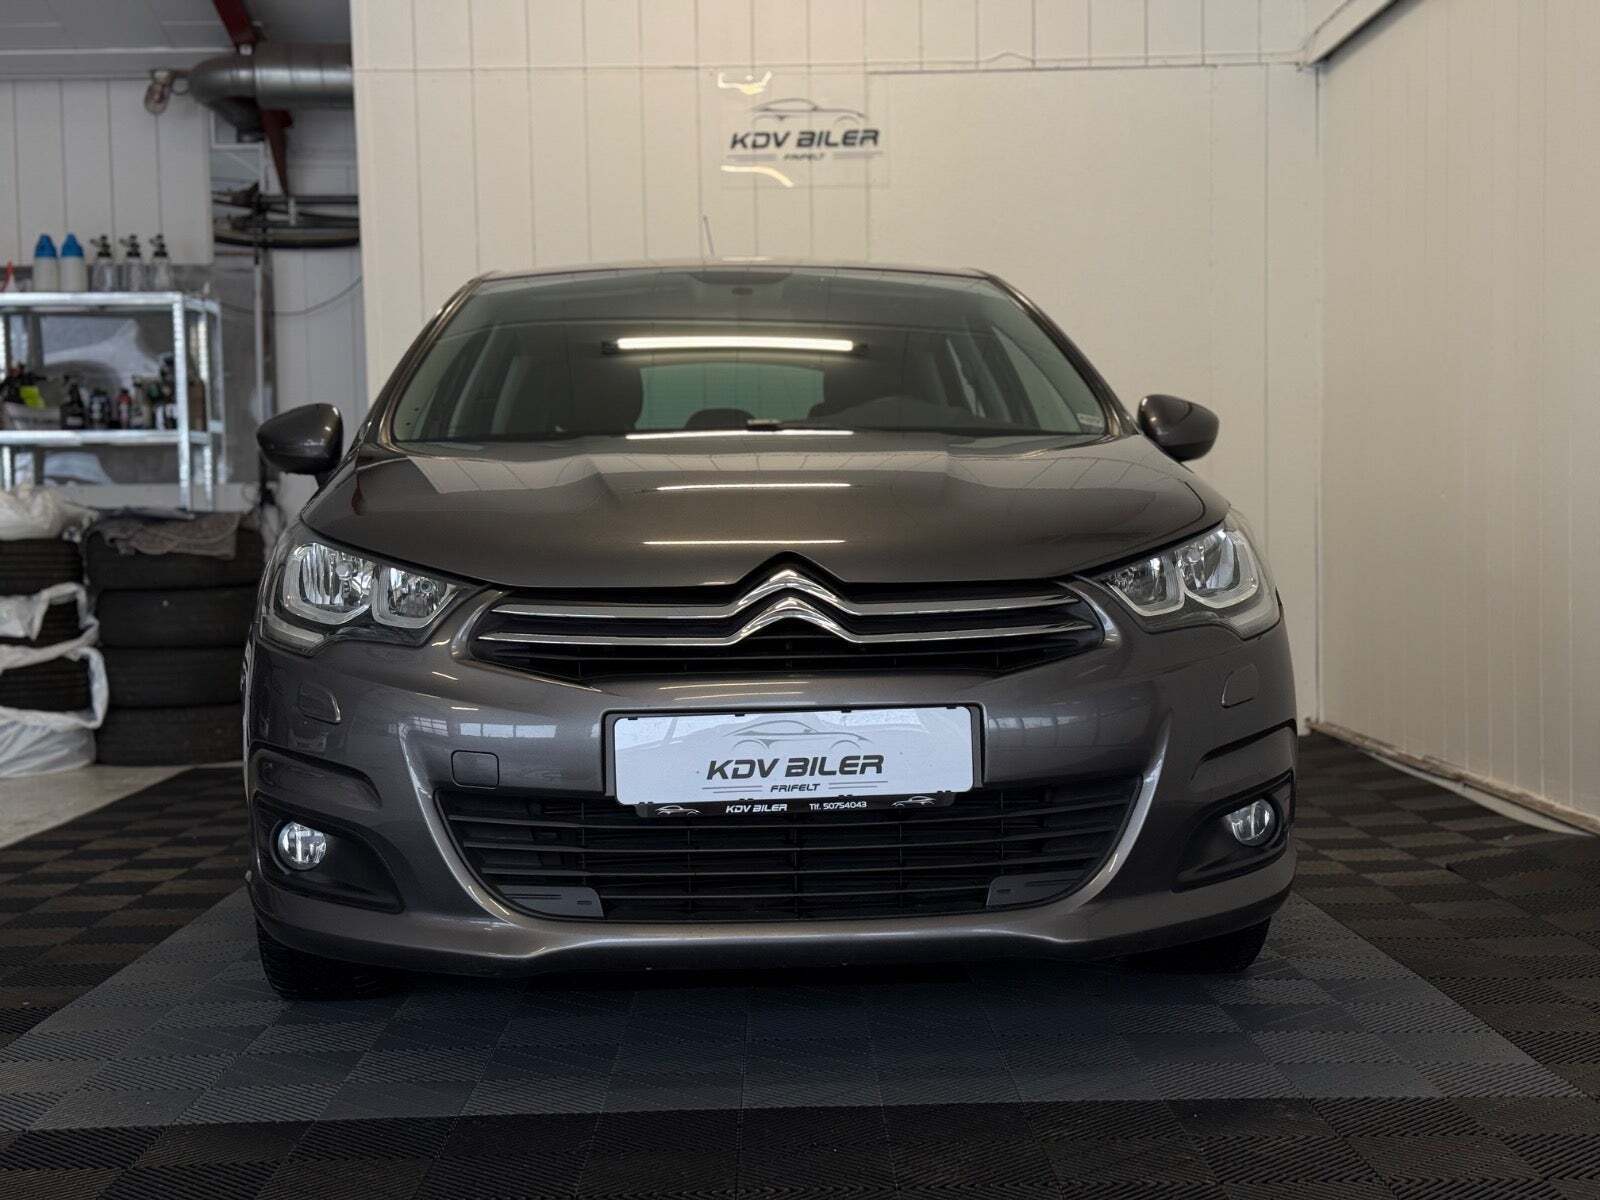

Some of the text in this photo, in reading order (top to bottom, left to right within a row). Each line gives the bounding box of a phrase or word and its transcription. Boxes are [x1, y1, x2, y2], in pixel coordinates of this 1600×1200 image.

[730, 129, 880, 150] KDV BILER
[706, 754, 884, 780] KDV BILER
[770, 783, 821, 793] FRIFELT
[726, 803, 788, 814] KDV BILER
[823, 801, 868, 810] 50754043
